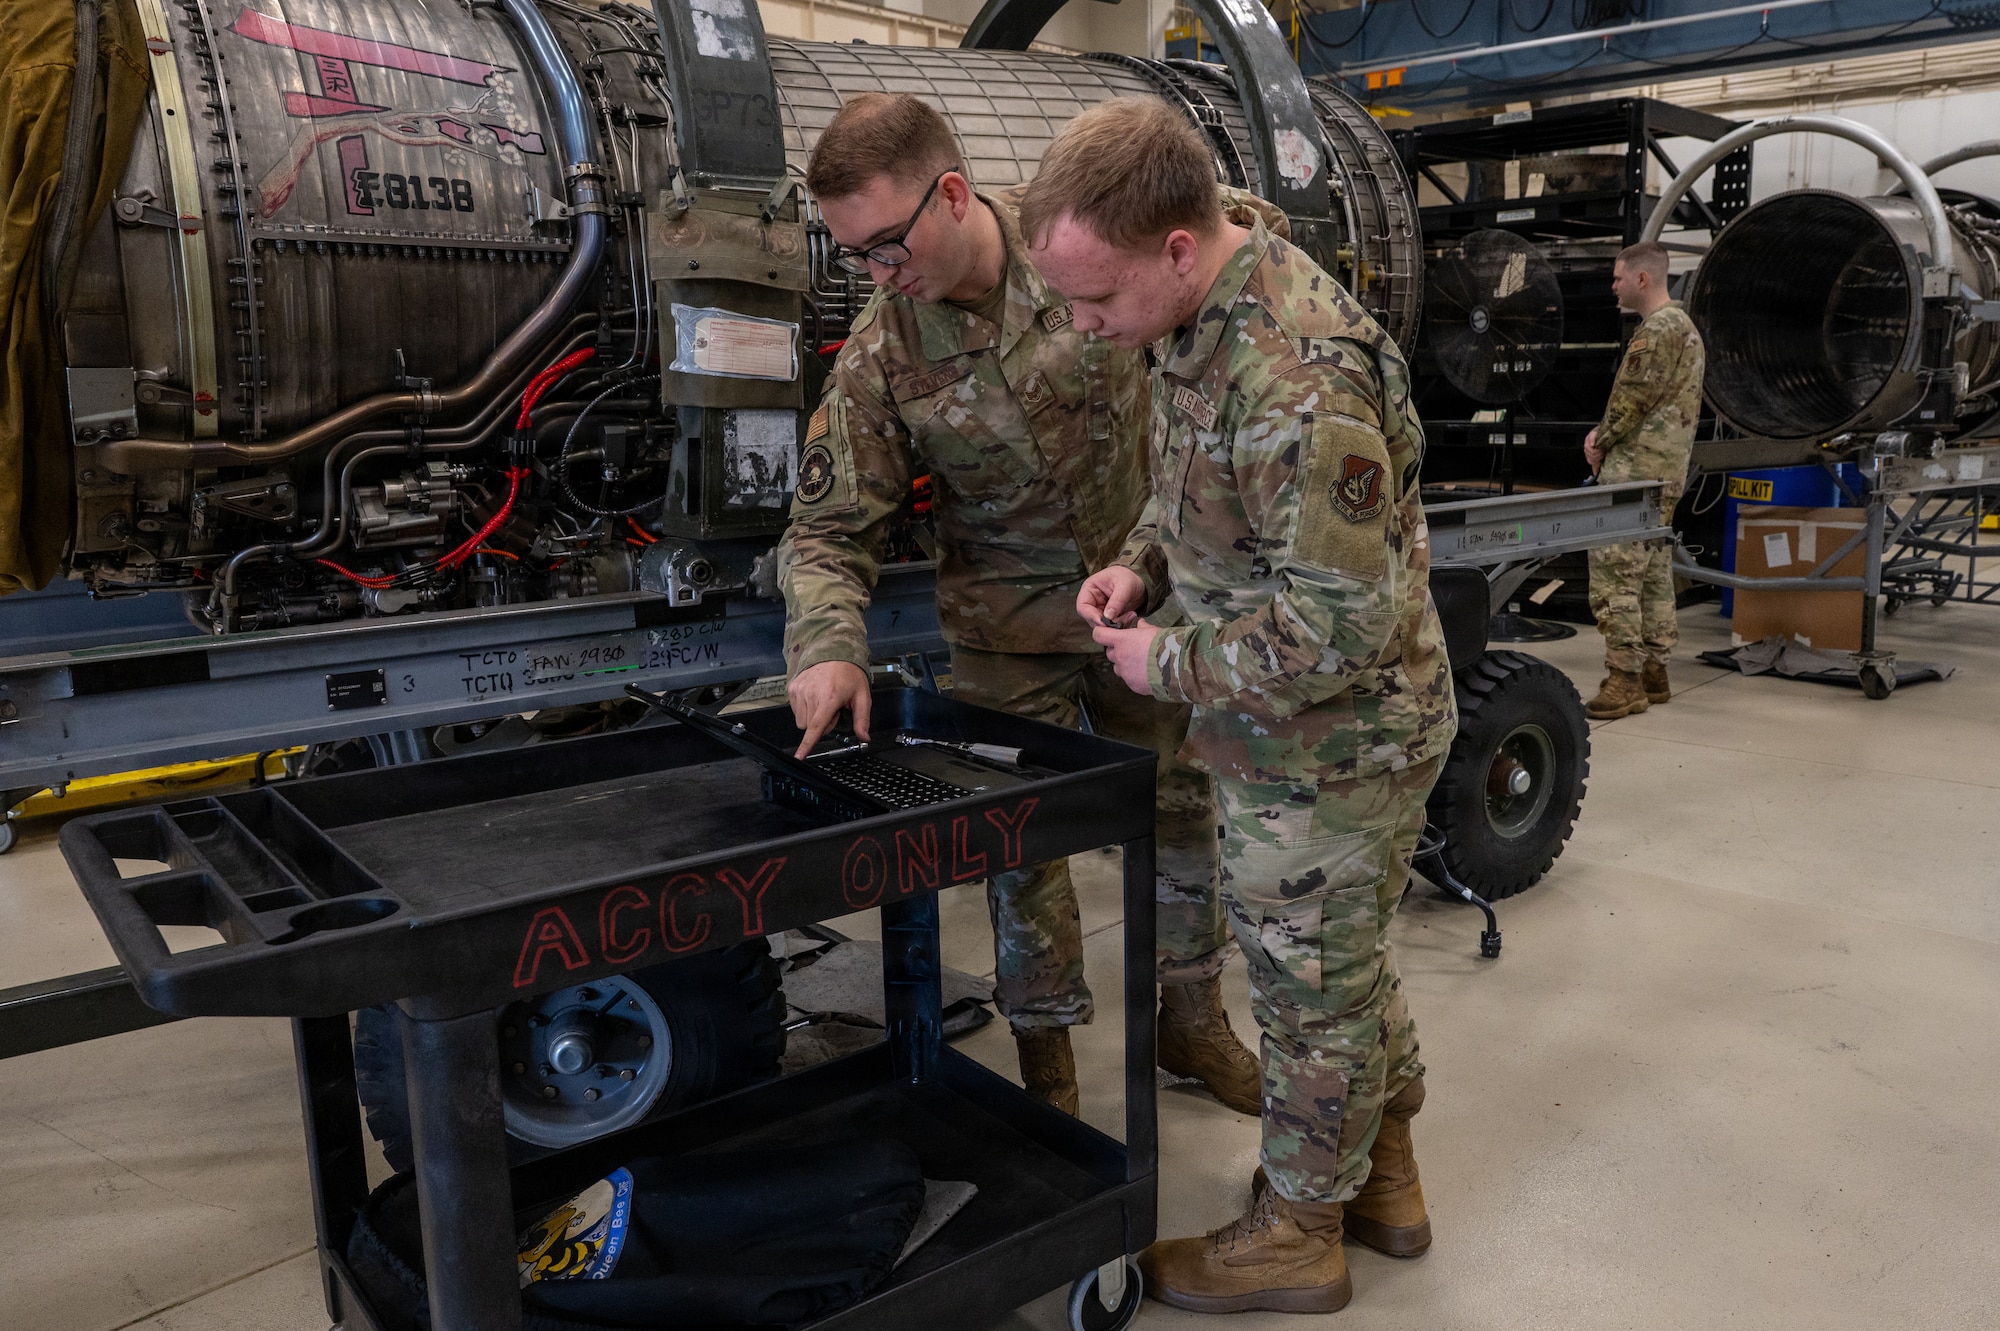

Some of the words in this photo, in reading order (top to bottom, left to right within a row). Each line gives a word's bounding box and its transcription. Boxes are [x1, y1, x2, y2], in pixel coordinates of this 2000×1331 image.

[1751, 481, 1771, 498] KIT
[1552, 523, 1561, 535] 17
[891, 610, 900, 628] 7
[459, 651, 517, 672] TCTO
[403, 675, 415, 692] 3
[512, 857, 788, 989] ACCY
[842, 798, 1040, 910] ONLY
[611, 1200, 626, 1229] Bee
